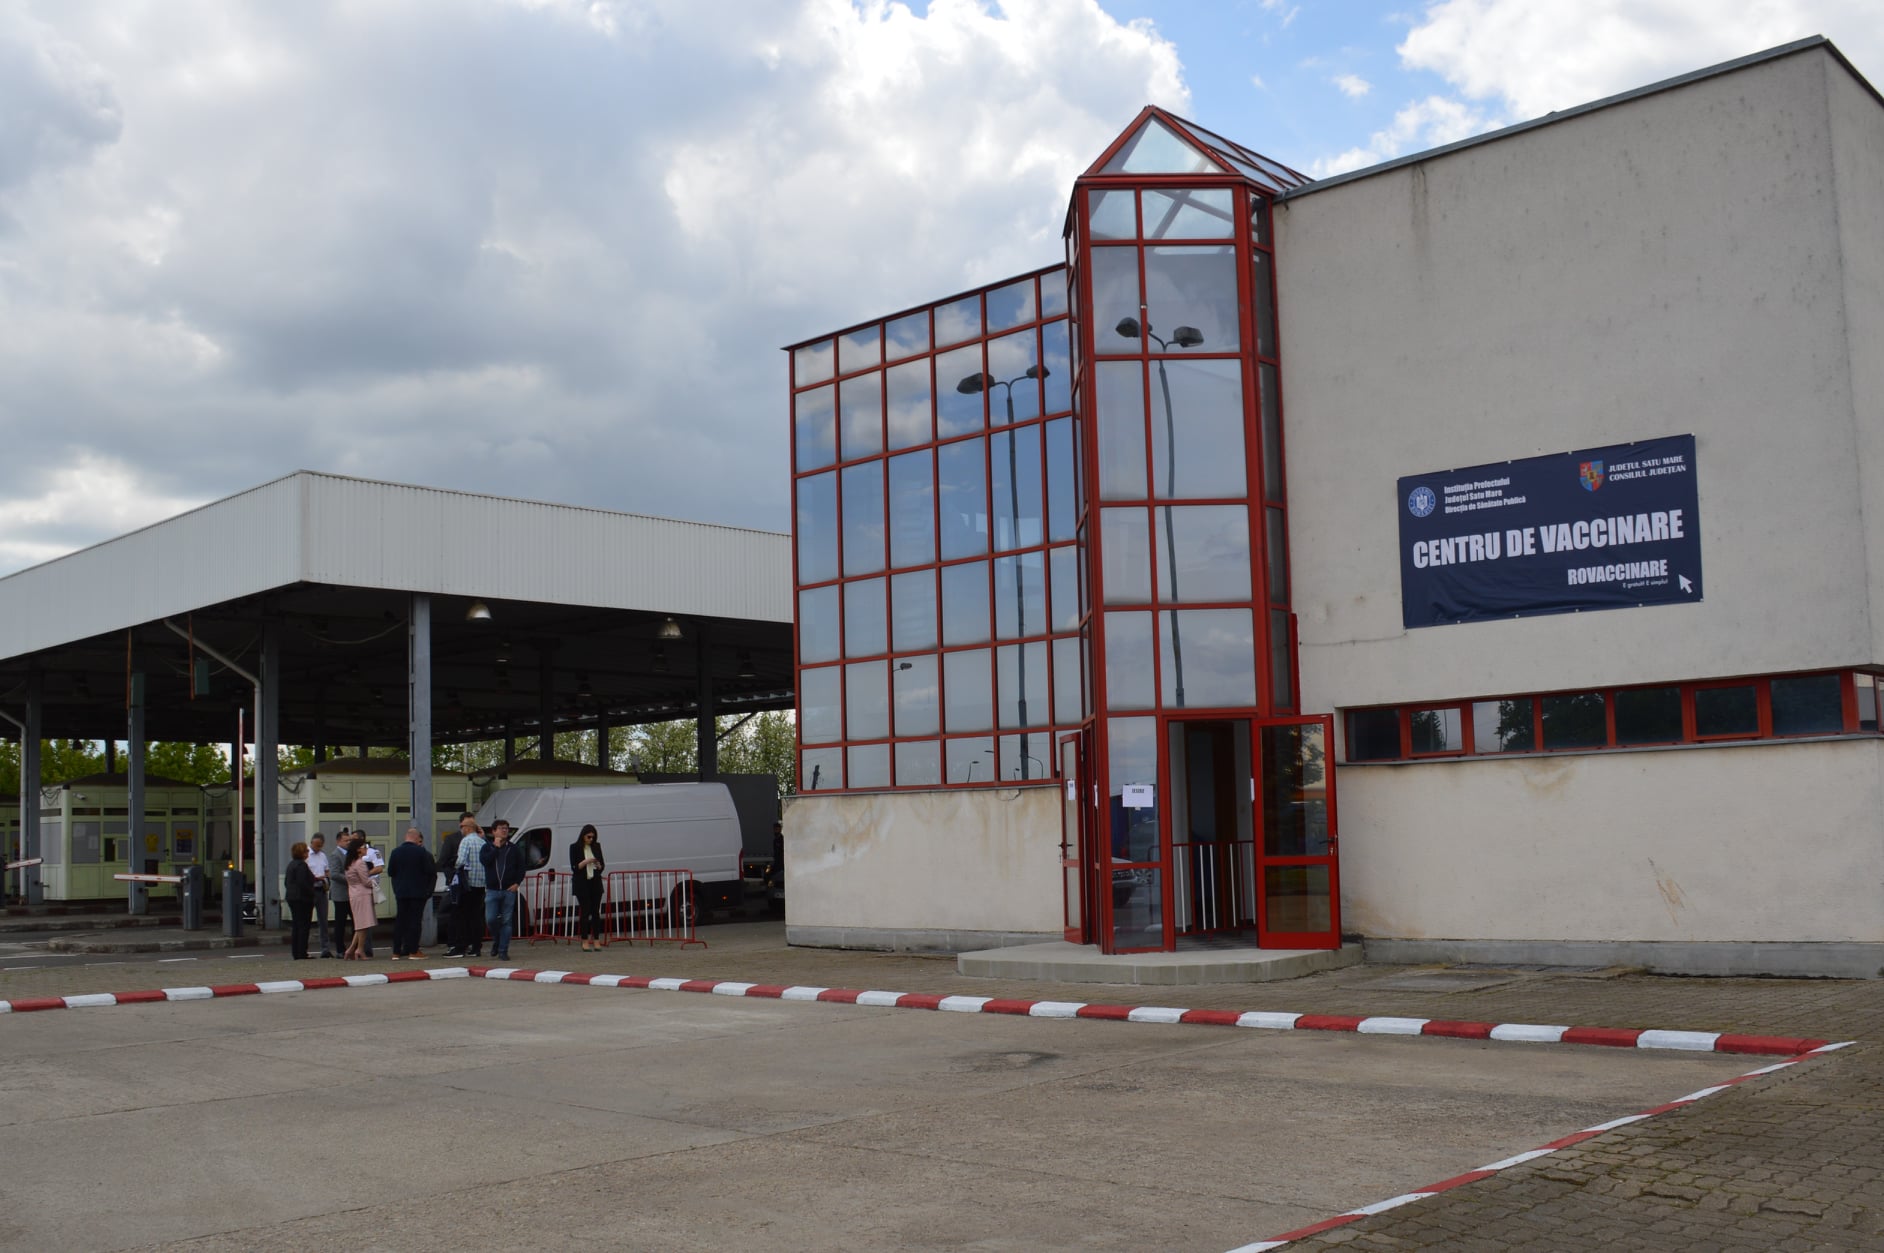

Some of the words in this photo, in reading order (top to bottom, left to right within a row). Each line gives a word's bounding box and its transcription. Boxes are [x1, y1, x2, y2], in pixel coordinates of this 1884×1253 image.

[1641, 458, 1661, 468] SATU
[1662, 455, 1684, 465] MARE
[1609, 470, 1648, 481] CONSILIUL
[1413, 531, 1500, 568] CENTRU
[1506, 527, 1536, 558] DE
[1539, 508, 1684, 554] VACCINARE
[1567, 559, 1668, 585] ROVACCINARE
